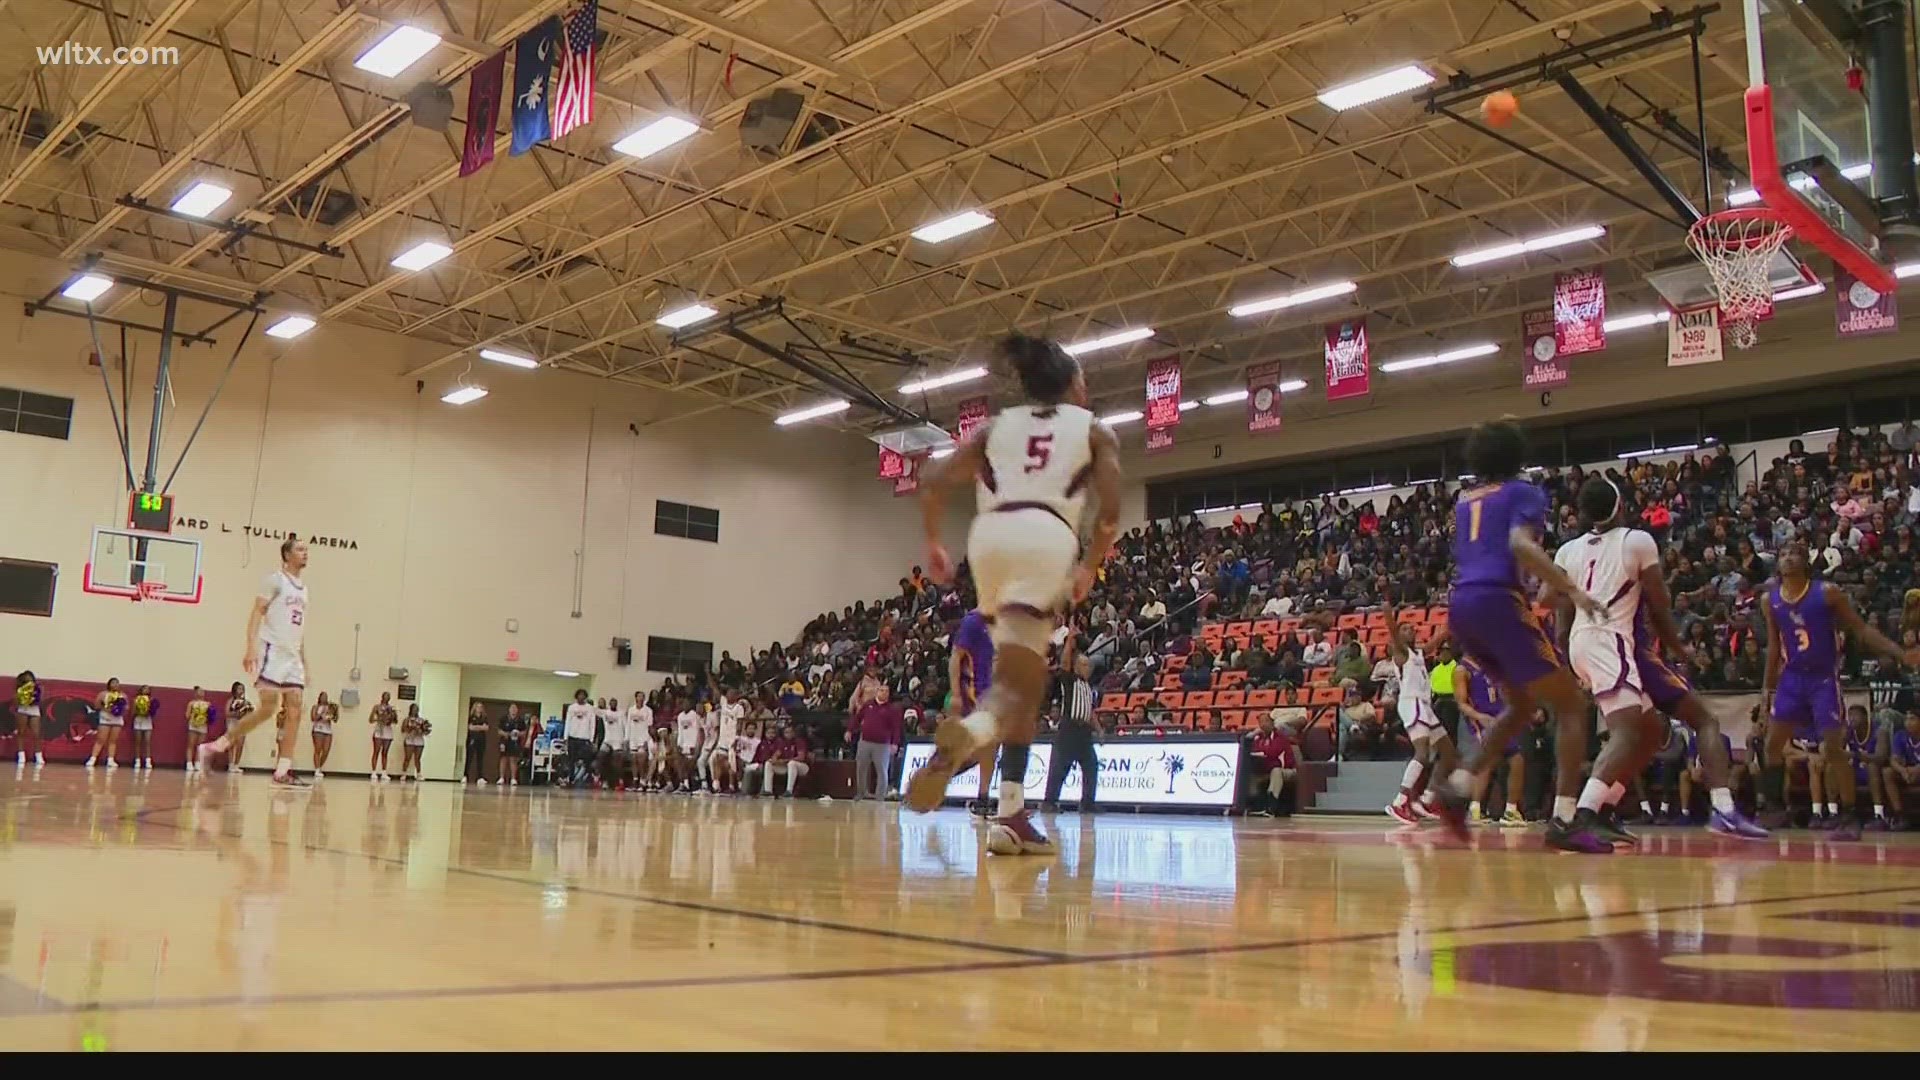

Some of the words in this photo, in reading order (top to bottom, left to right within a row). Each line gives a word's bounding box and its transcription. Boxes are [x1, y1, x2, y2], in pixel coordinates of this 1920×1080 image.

[1682, 329, 1706, 344] 1989
[1541, 391, 1551, 407] C
[1024, 432, 1054, 474] 5
[174, 517, 209, 530] ARD
[309, 535, 358, 550] ARENA
[1469, 500, 1482, 542] 1
[1586, 558, 1597, 592] 1
[1794, 628, 1810, 652] 3
[1135, 754, 1153, 773] of
